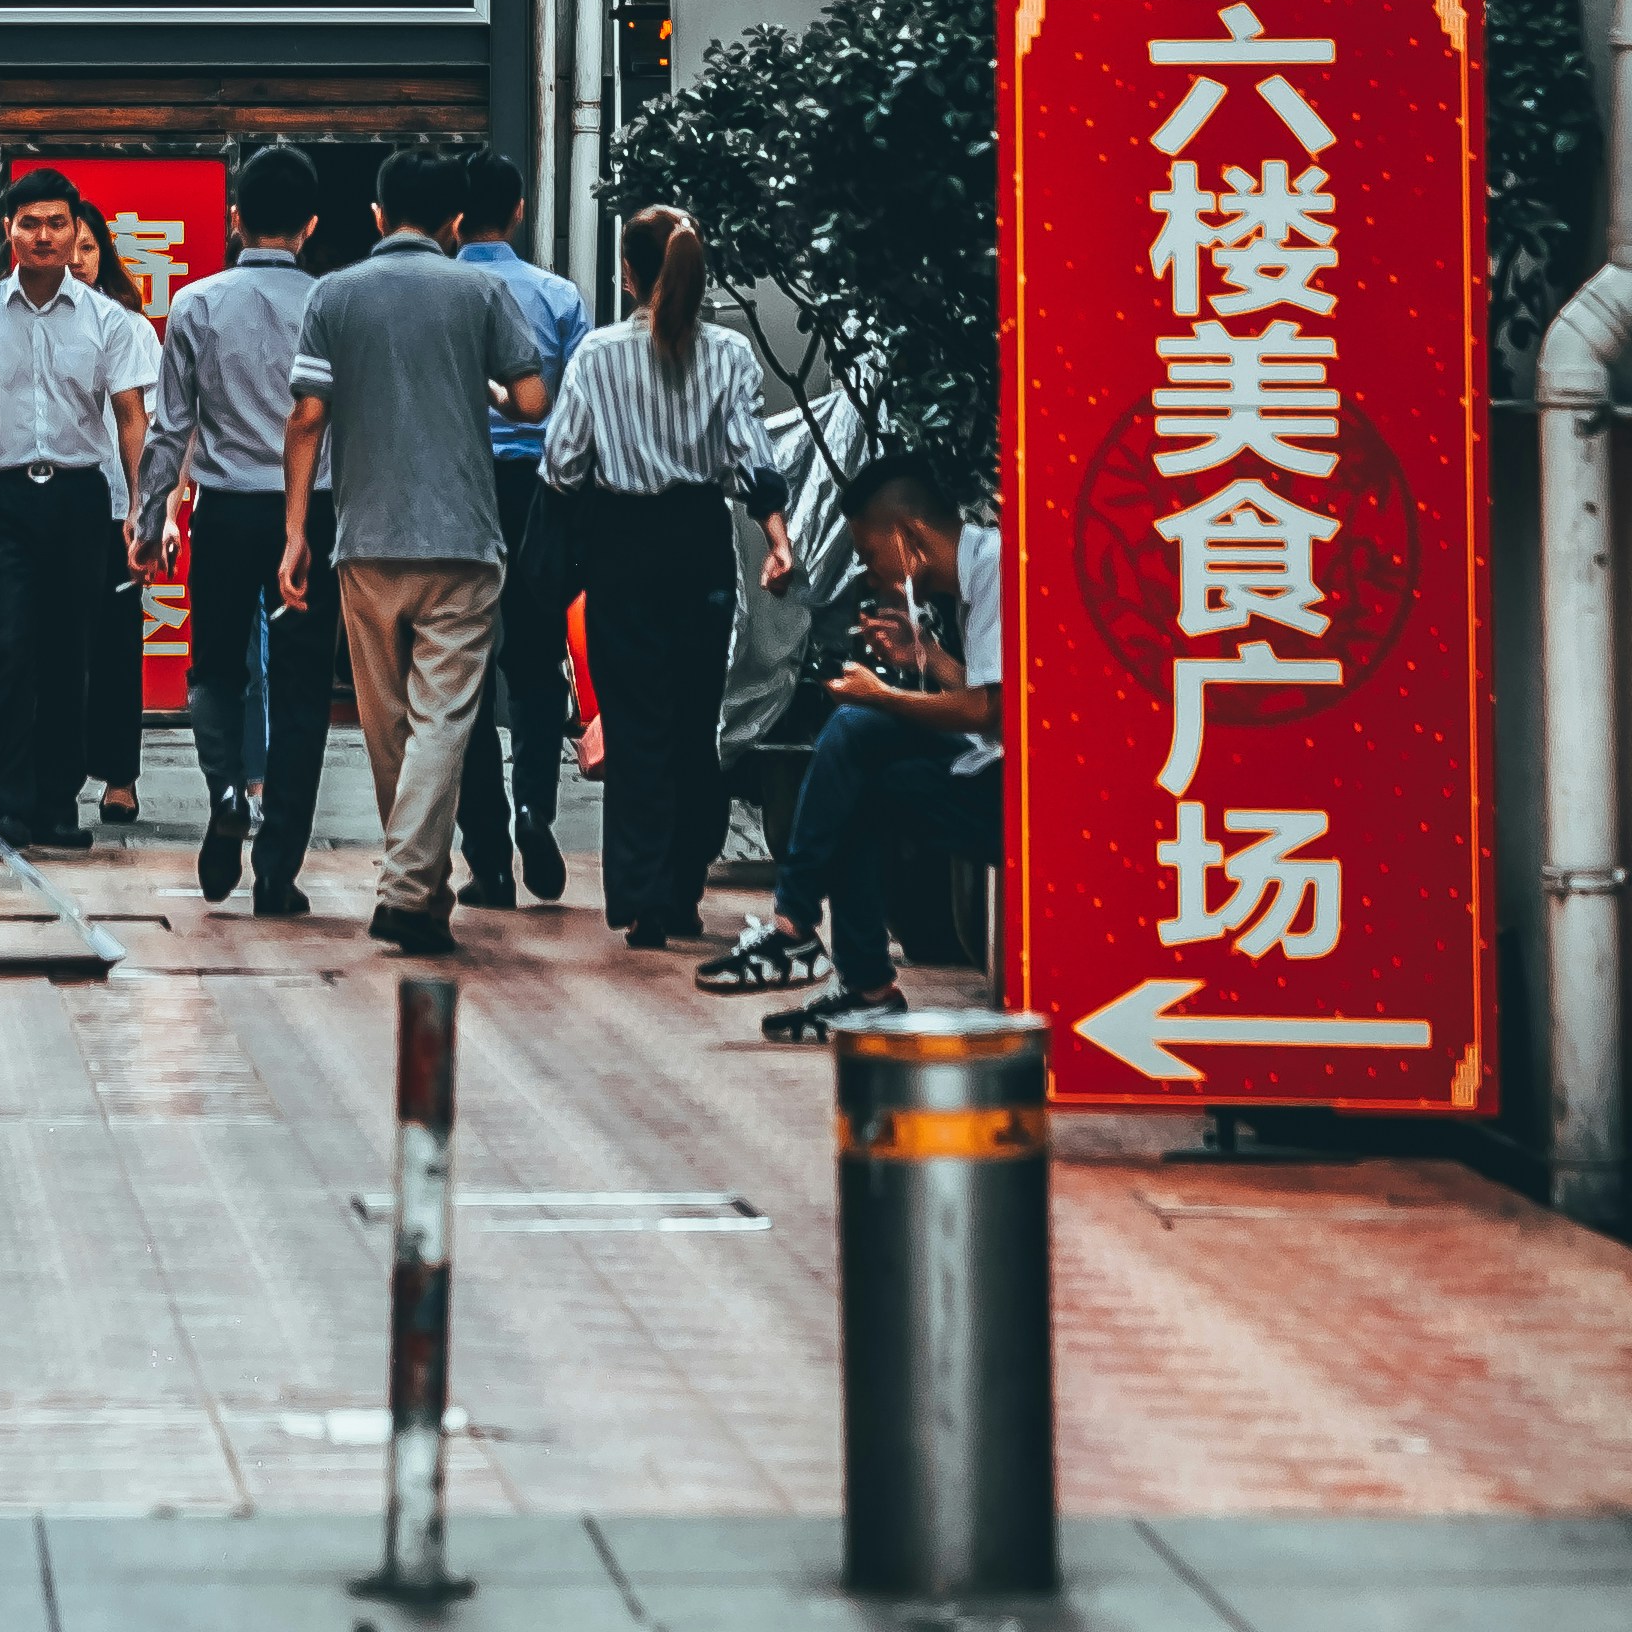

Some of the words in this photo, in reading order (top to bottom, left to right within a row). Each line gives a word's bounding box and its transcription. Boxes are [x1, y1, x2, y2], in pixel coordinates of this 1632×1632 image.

[1148, 0, 1345, 963] 六楼美食广场
